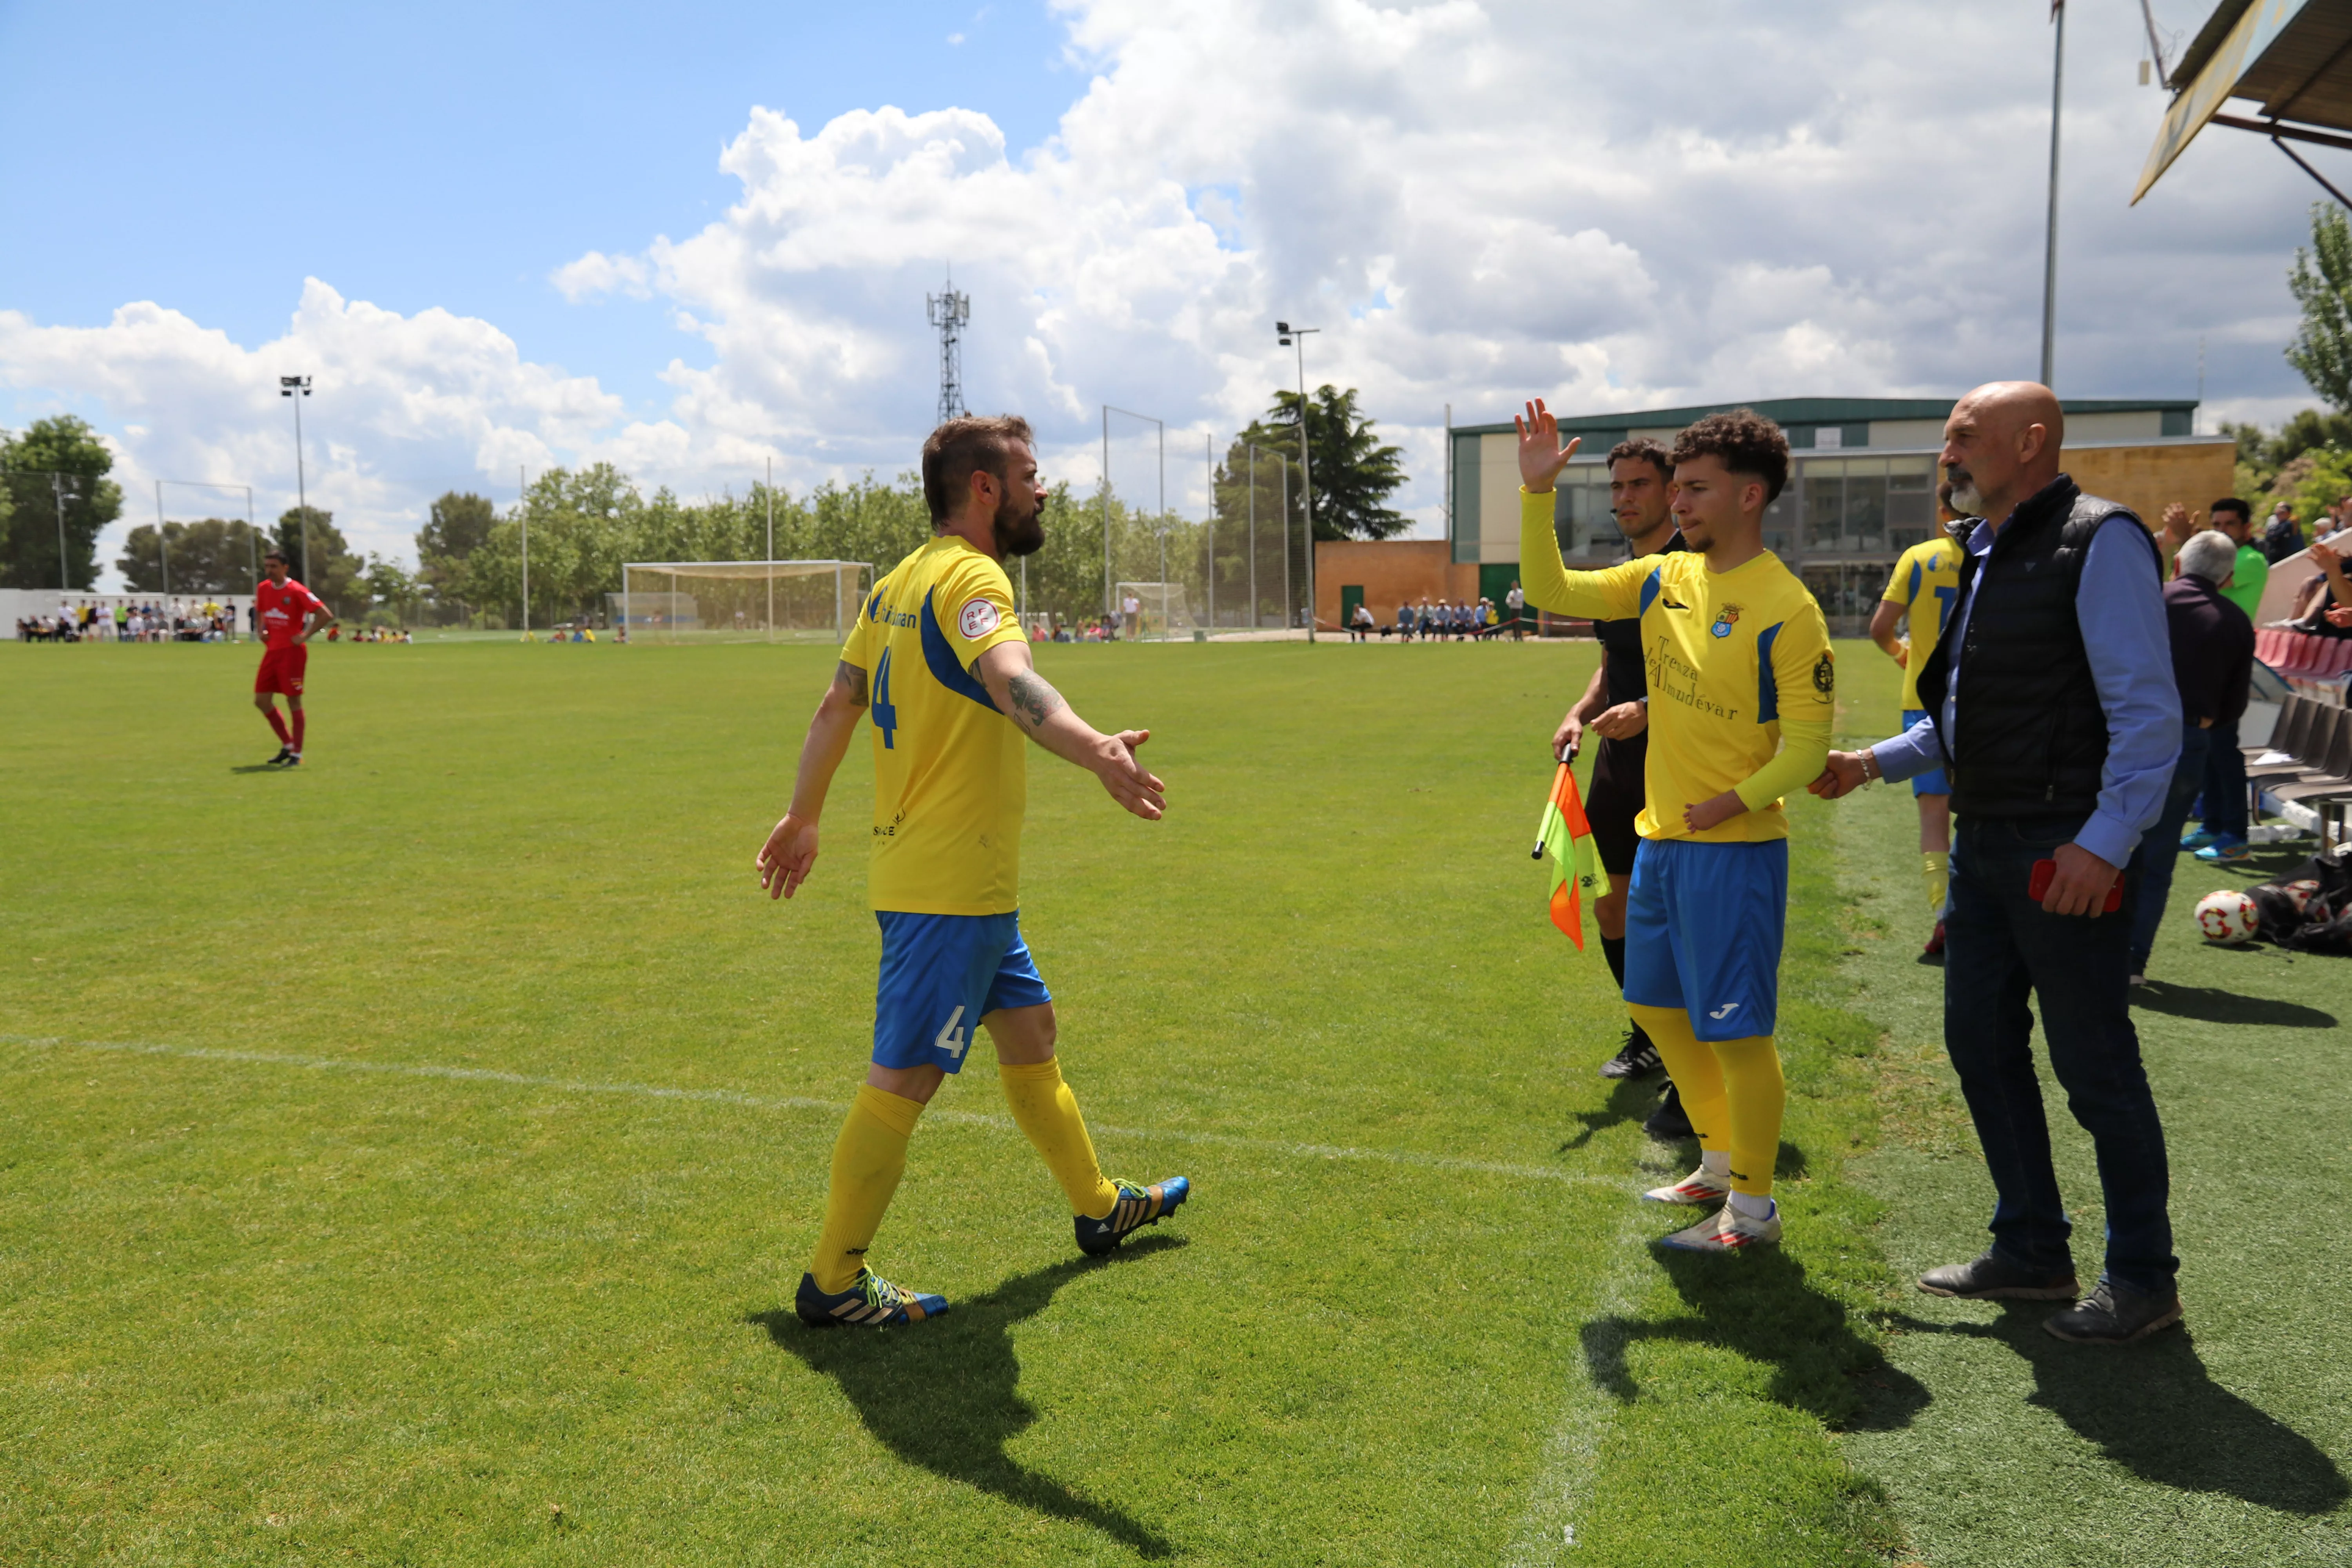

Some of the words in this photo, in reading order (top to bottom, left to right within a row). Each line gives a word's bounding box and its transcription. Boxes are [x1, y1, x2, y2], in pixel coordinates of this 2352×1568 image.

[872, 646, 897, 749] 4
[1648, 663, 1737, 720] Almudévar
[935, 1005, 965, 1058] 4
